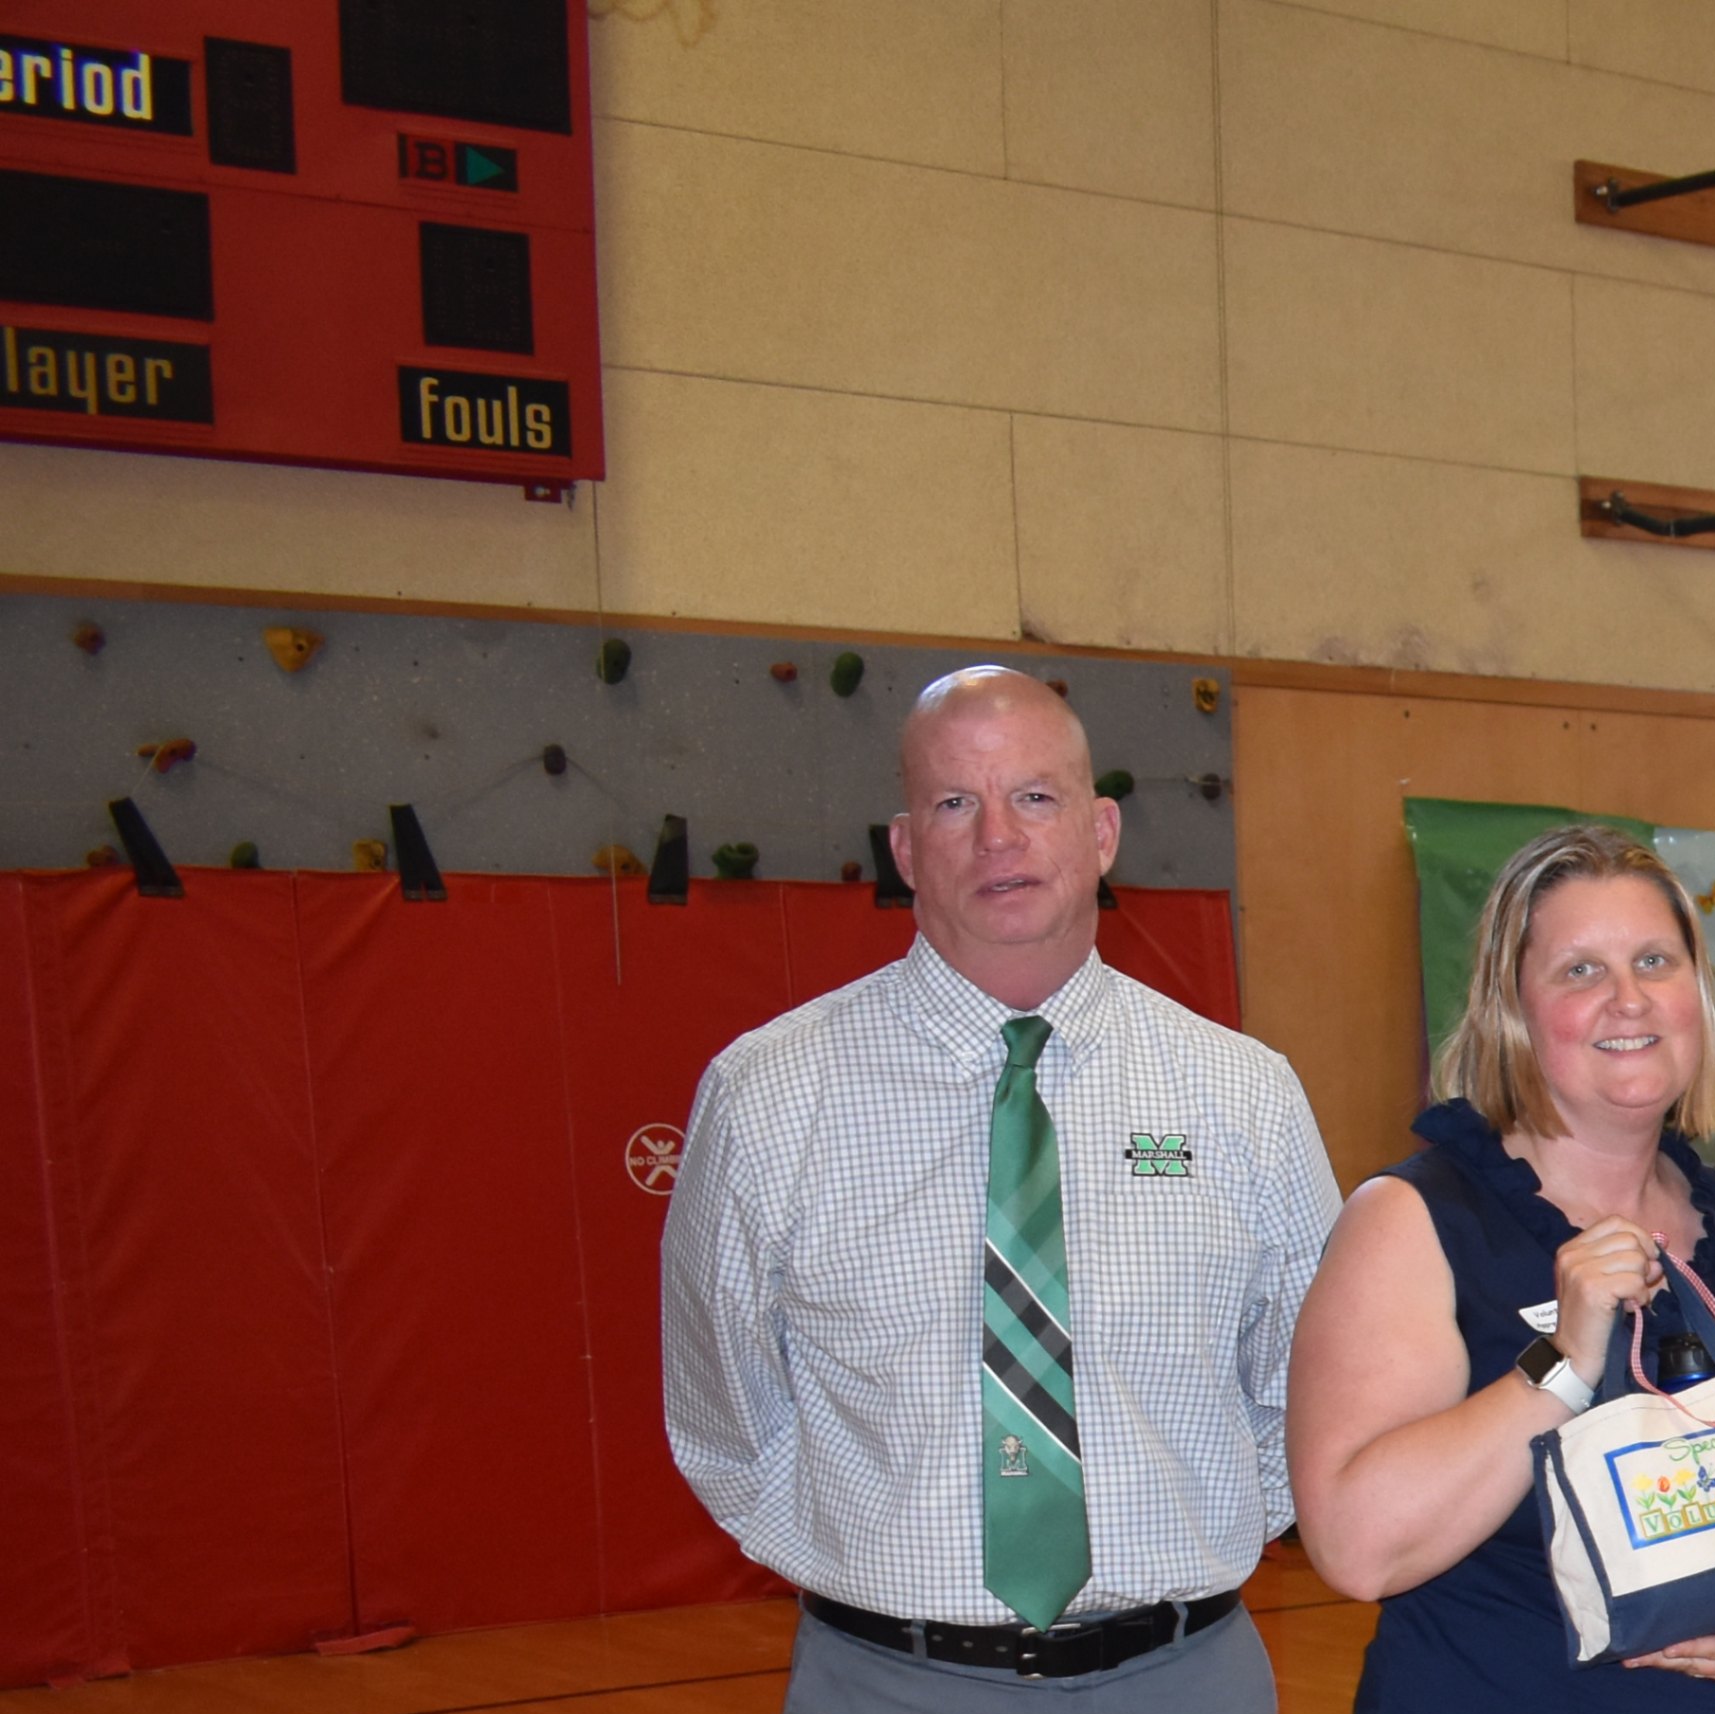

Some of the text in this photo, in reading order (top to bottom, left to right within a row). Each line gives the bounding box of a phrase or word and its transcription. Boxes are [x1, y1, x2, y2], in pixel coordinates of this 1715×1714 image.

[3, 326, 174, 415] layer
[418, 376, 552, 451] fouls
[629, 1157, 645, 1166] NO
[1132, 1150, 1186, 1159] MARSHALL
